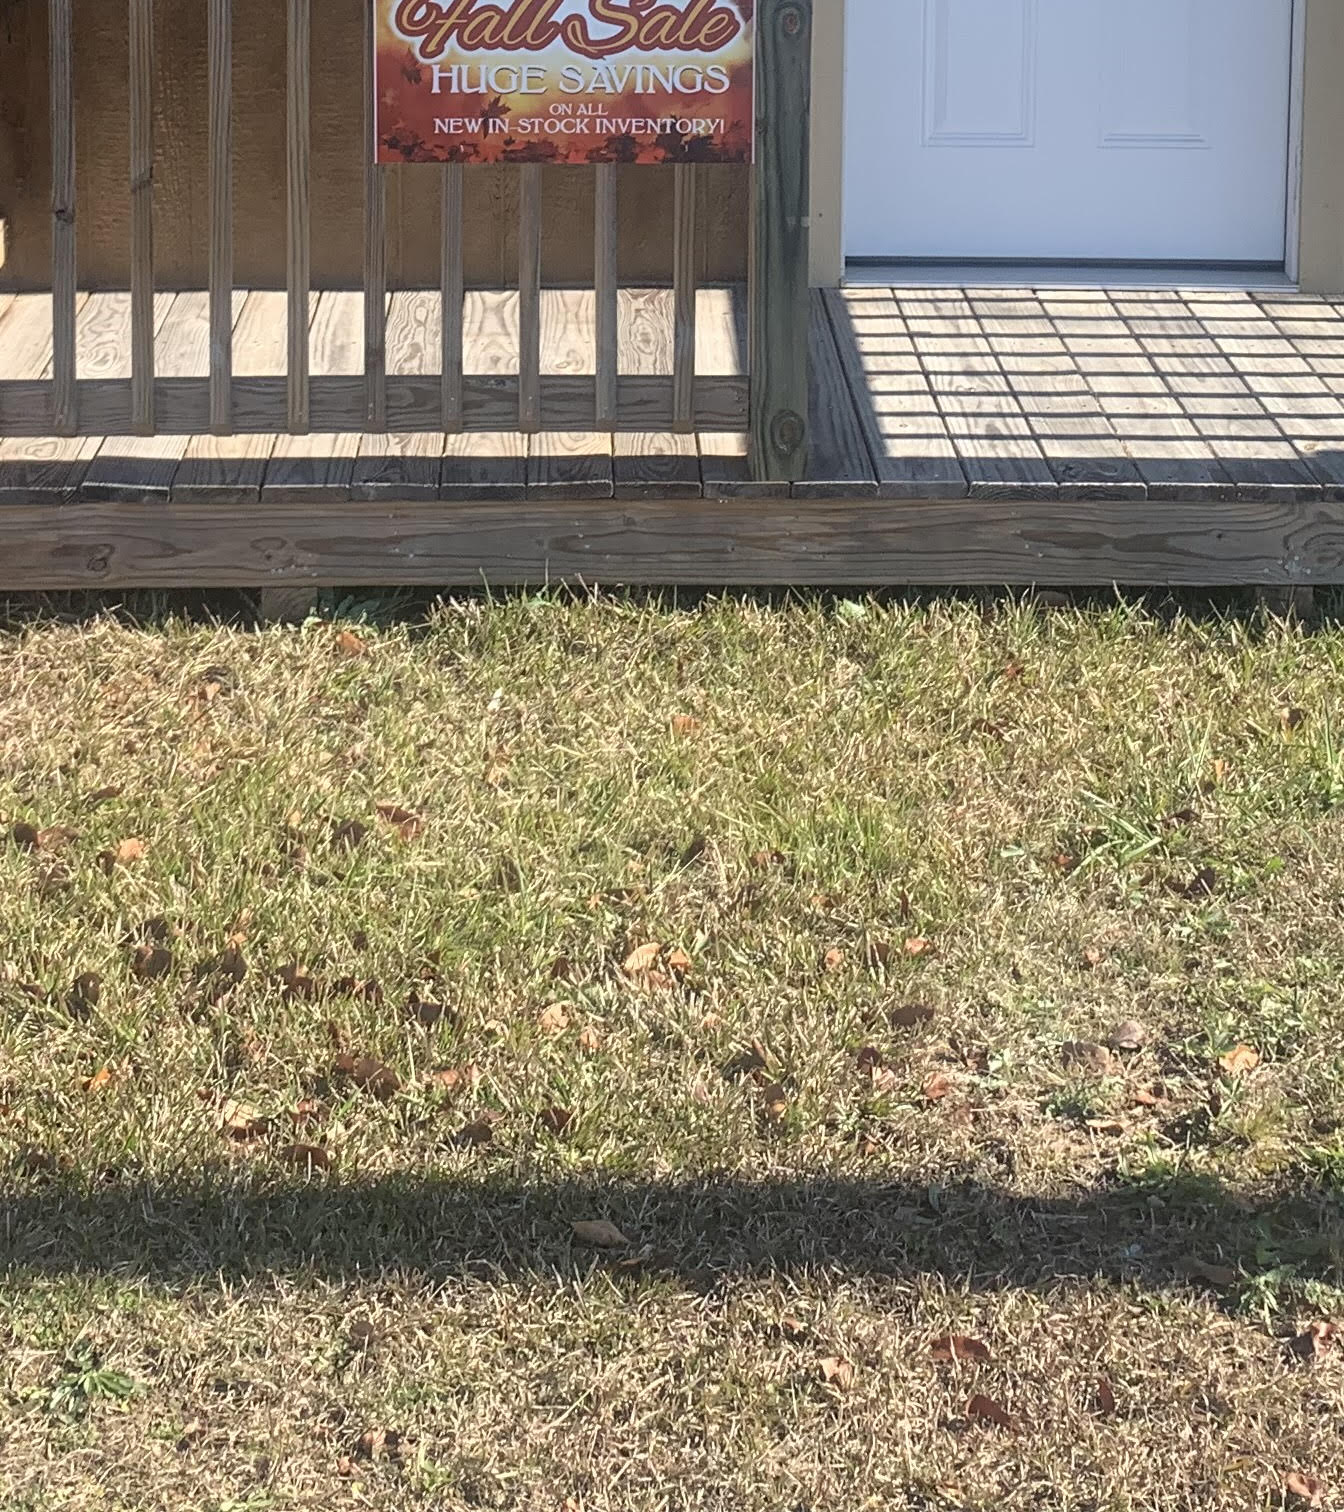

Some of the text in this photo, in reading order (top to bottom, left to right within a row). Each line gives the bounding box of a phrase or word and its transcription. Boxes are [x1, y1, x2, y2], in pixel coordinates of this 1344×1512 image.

[430, 64, 731, 95] HUGE SAVINGS
[549, 103, 609, 116] ON ALL
[433, 118, 485, 134] NEW
[487, 118, 591, 134] IN-STOCK
